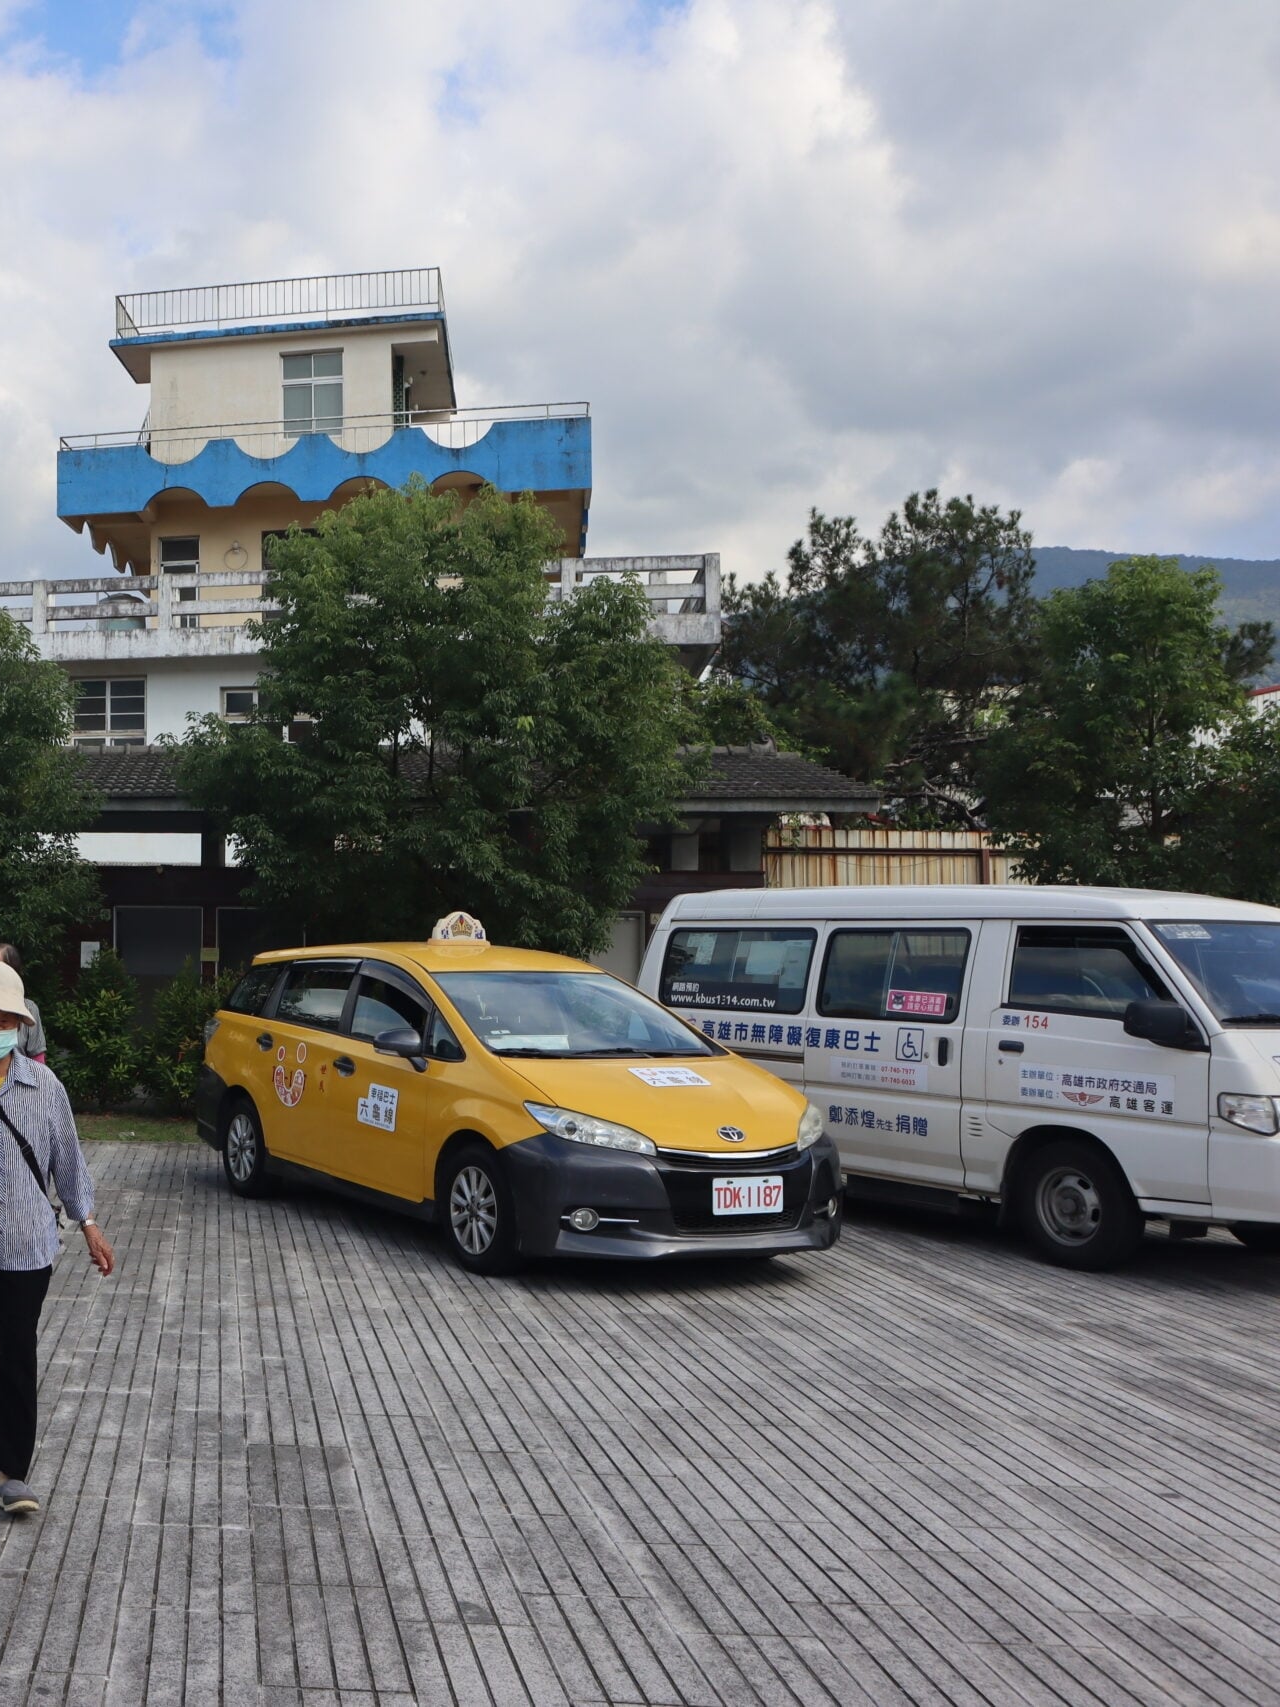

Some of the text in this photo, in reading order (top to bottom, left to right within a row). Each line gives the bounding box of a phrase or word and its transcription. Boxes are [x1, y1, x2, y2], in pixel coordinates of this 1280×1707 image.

[1024, 1015, 1048, 1029] 154
[702, 1020, 881, 1053] 高雄市無障礙復康巴士
[1061, 1073, 1158, 1096] 高雄市政府交通局
[360, 1100, 394, 1125] 六龜線
[1109, 1095, 1174, 1115] 高雄客運
